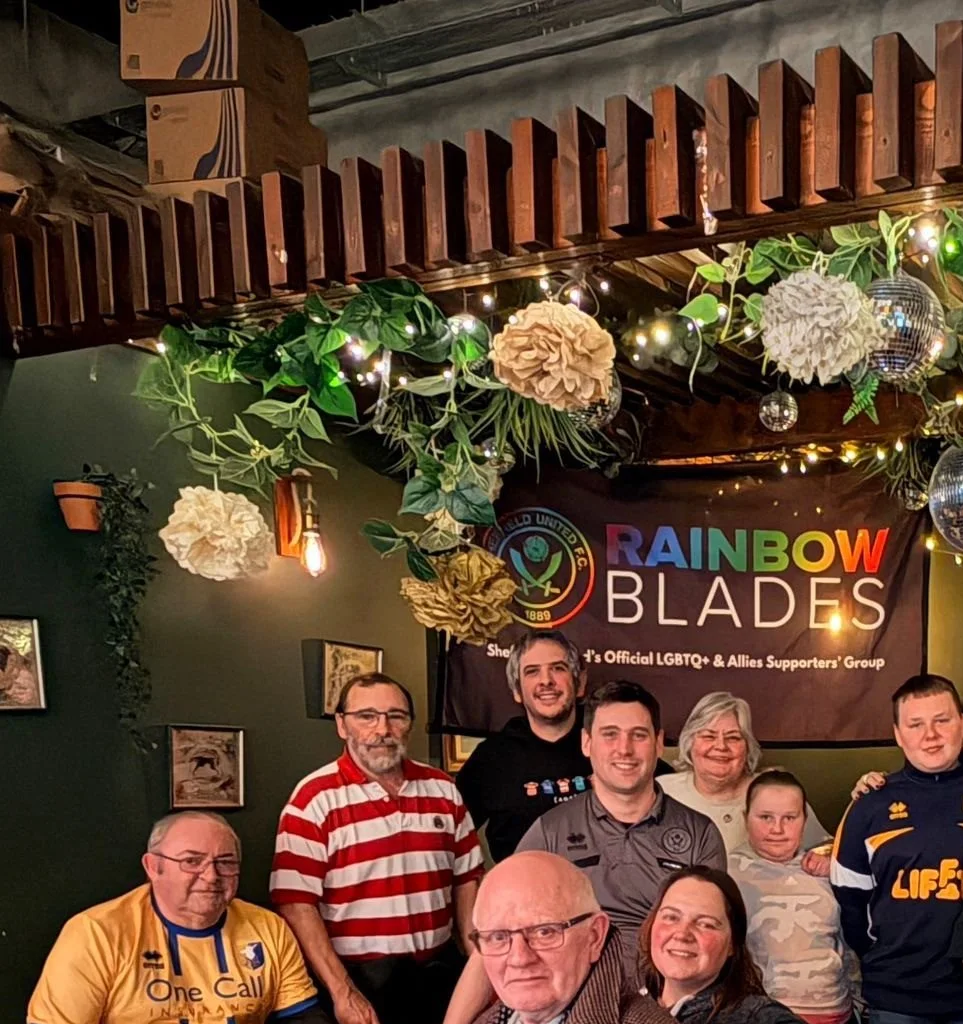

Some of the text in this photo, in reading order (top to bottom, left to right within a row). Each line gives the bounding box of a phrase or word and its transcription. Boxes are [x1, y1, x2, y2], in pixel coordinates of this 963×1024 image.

[536, 513, 577, 545] UNITED
[606, 523, 890, 573] RAINBOW
[606, 569, 886, 631] BLADES
[525, 609, 552, 622] 1889
[604, 650, 653, 665] Official
[656, 652, 710, 669] LGBTQ+
[713, 653, 725, 668] &
[727, 654, 764, 669] Allies
[766, 655, 842, 672] Supporters'
[843, 655, 886, 672] Group
[146, 975, 263, 1002] One Call
